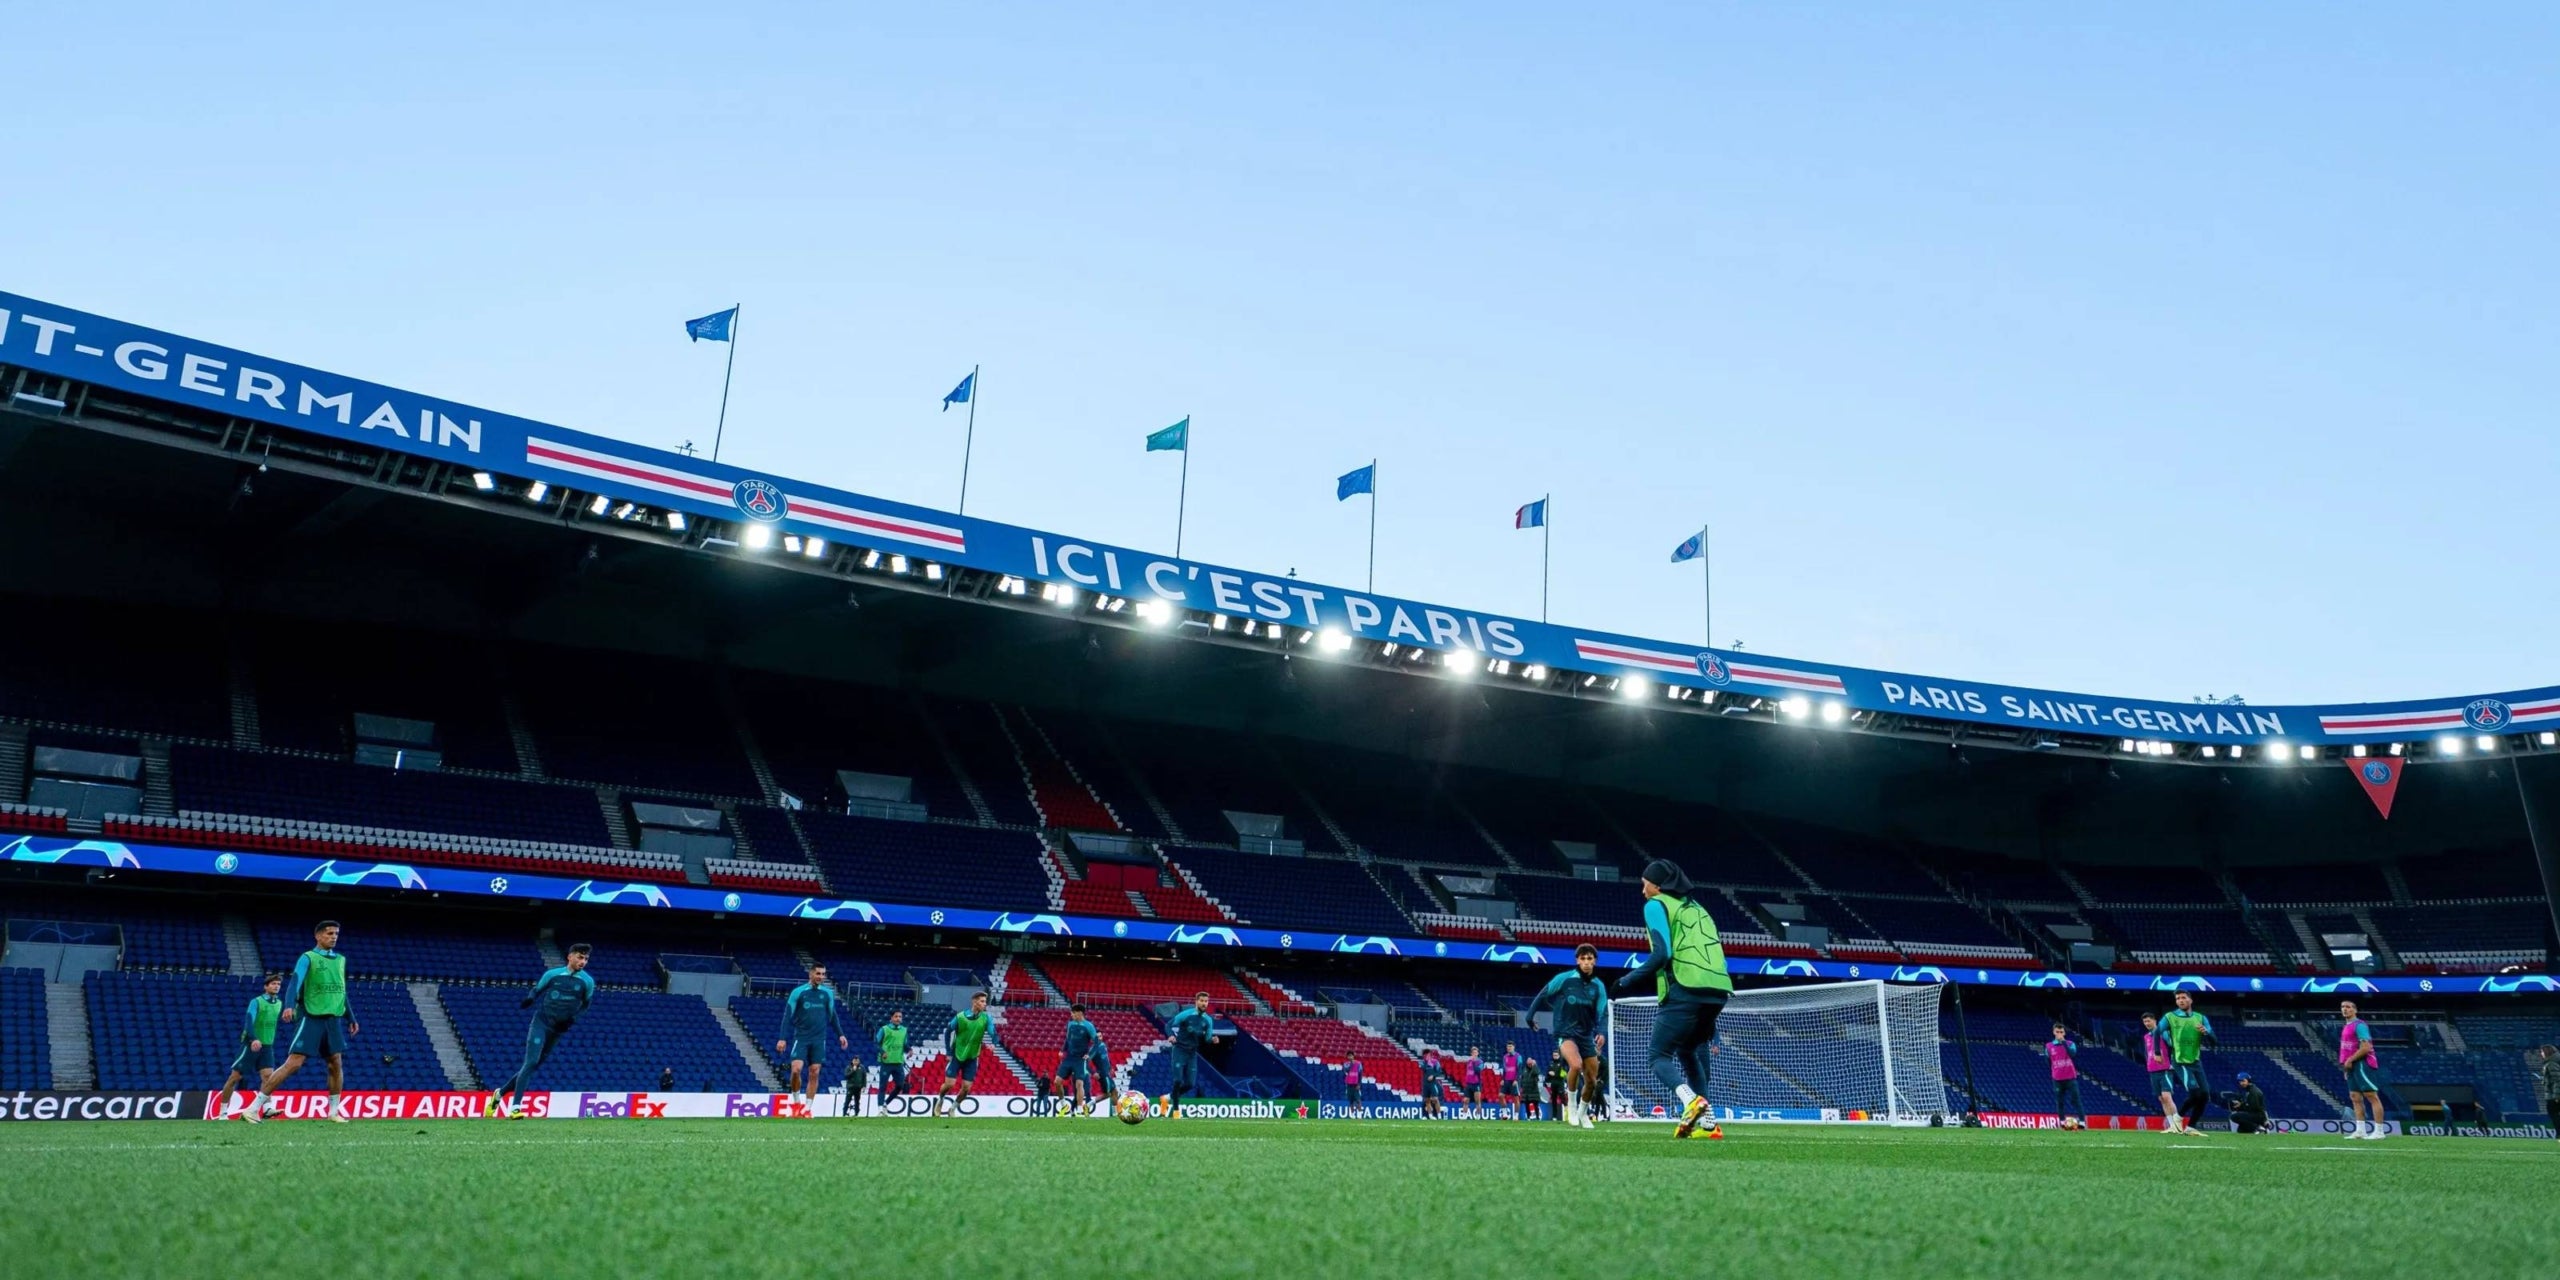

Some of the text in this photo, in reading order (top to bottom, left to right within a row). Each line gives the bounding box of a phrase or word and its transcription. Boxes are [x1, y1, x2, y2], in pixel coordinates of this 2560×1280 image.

[742, 481, 776, 495] PARIS
[1031, 537, 1524, 656] ICI C'EST PARIS
[1881, 682, 2285, 735] PARIS SAINT-GERMAIN
[578, 1093, 667, 1118] FedEx
[1178, 1100, 1285, 1118] responsibly
[1987, 1115, 2036, 1129] TURKISH
